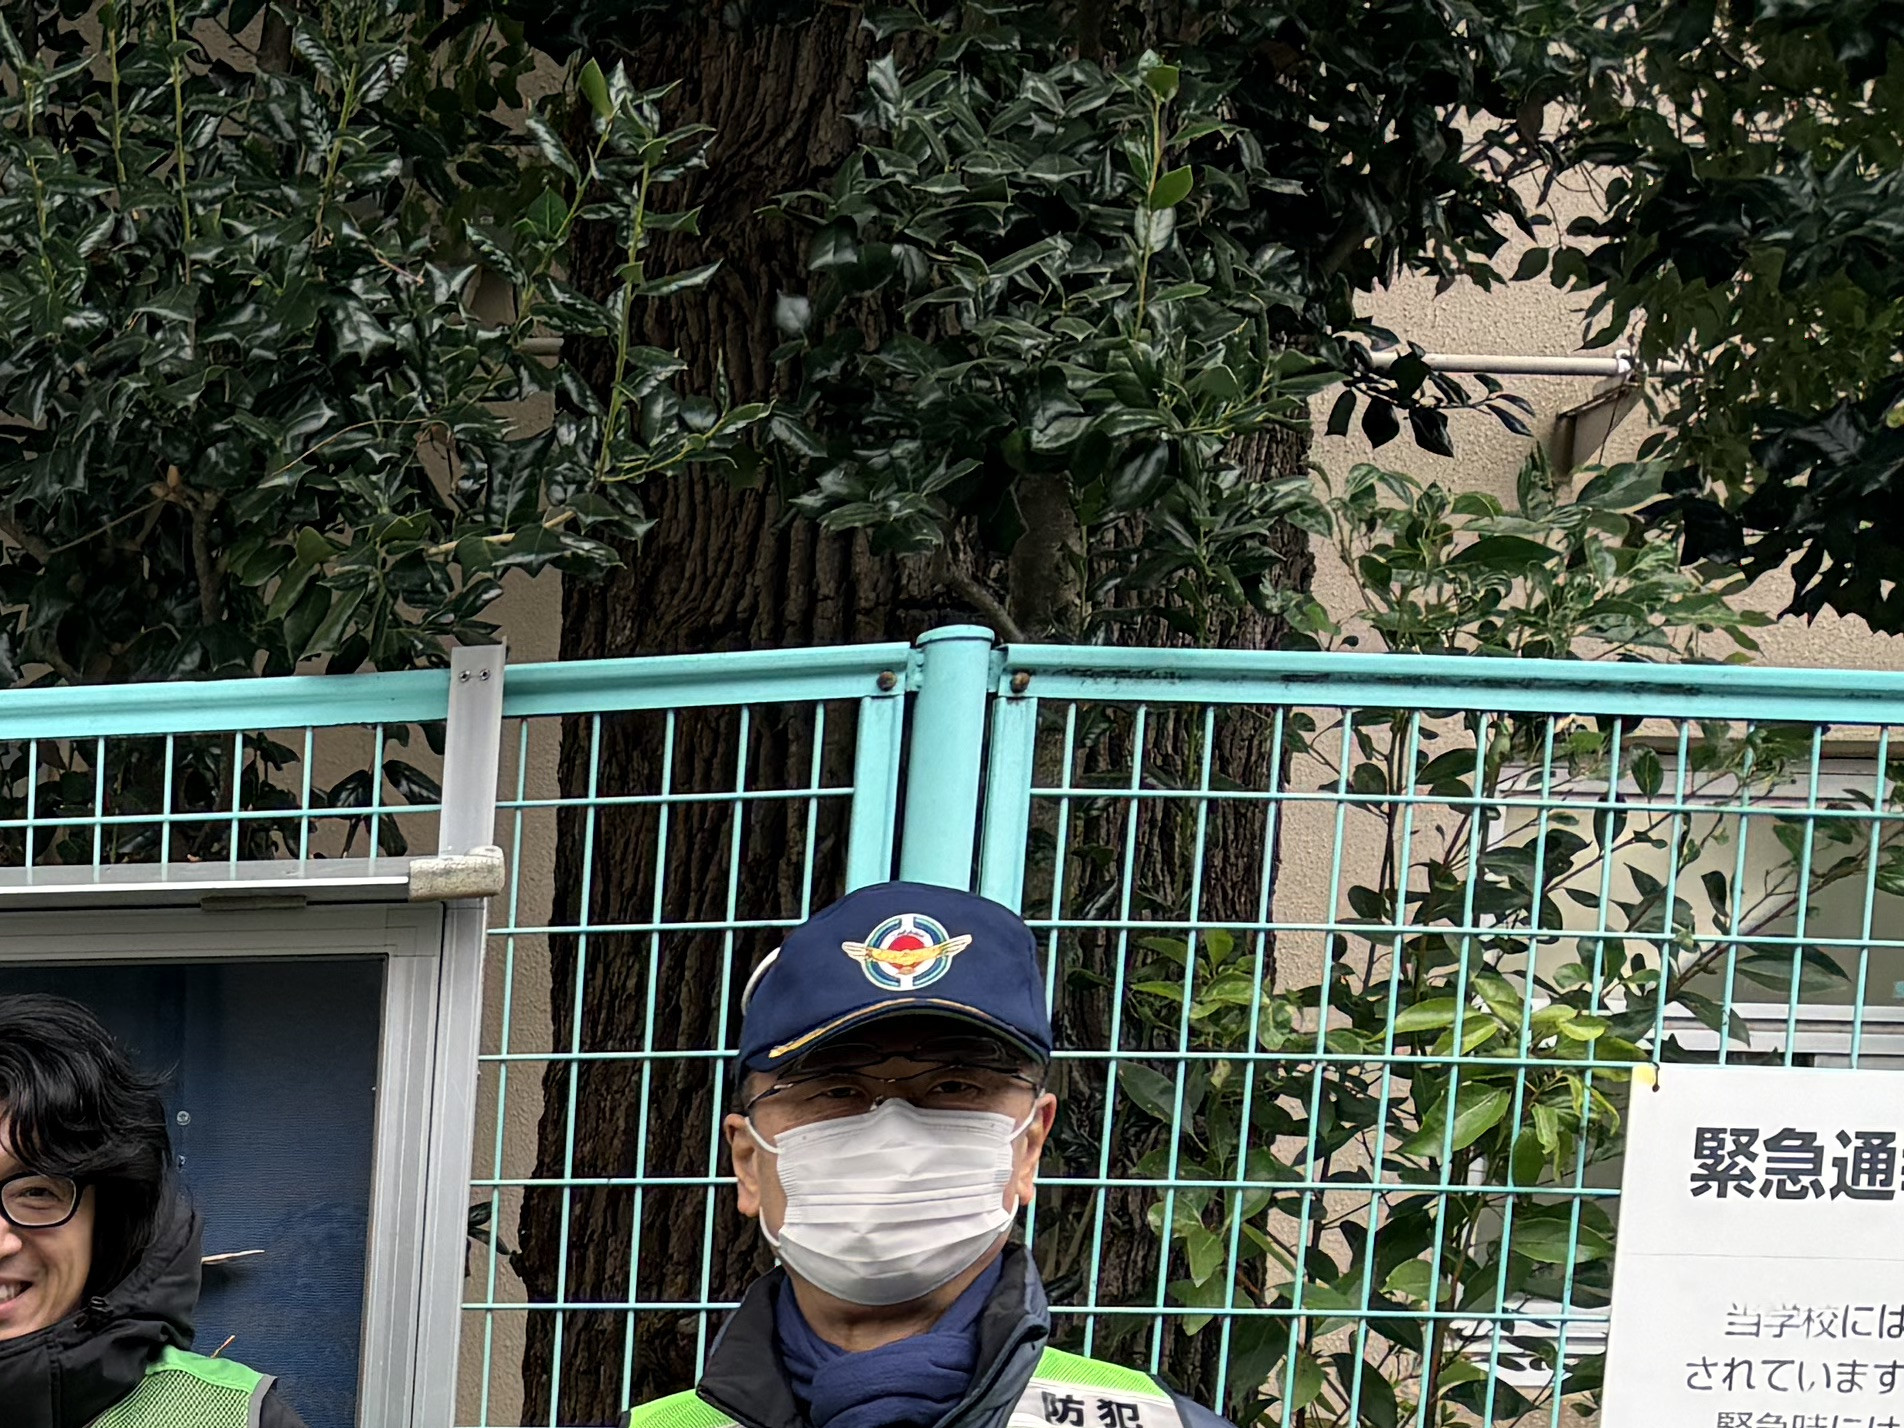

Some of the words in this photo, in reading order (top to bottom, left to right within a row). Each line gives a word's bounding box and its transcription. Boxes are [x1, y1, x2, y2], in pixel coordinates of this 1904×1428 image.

[1690, 1127, 1904, 1200] 緊急通
[1724, 1303, 1904, 1339] 当学校には
[1686, 1356, 1904, 1394] されています
